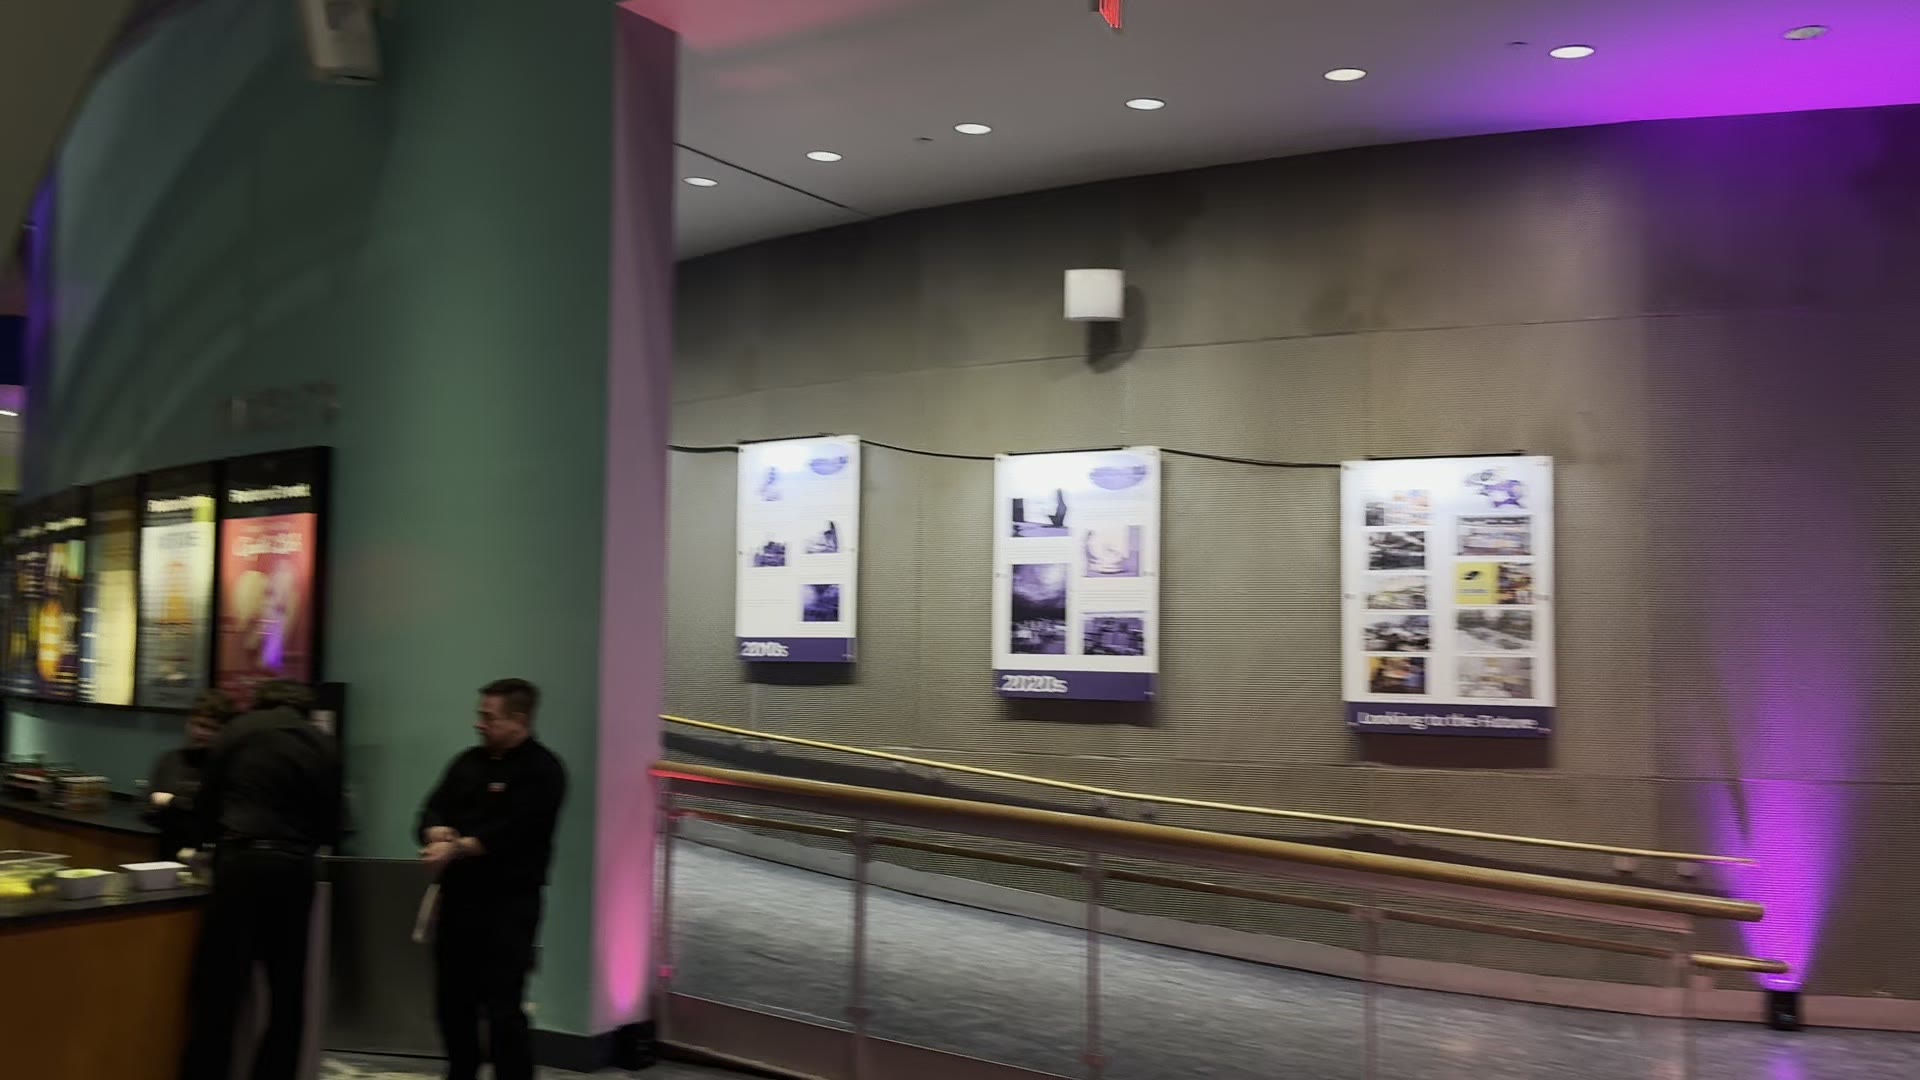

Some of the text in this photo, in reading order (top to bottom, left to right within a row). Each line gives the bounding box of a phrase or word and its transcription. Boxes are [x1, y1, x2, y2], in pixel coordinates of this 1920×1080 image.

[1001, 674, 1068, 693] 2020s
[1357, 711, 1428, 730] Looking
[1476, 714, 1539, 730] Future
